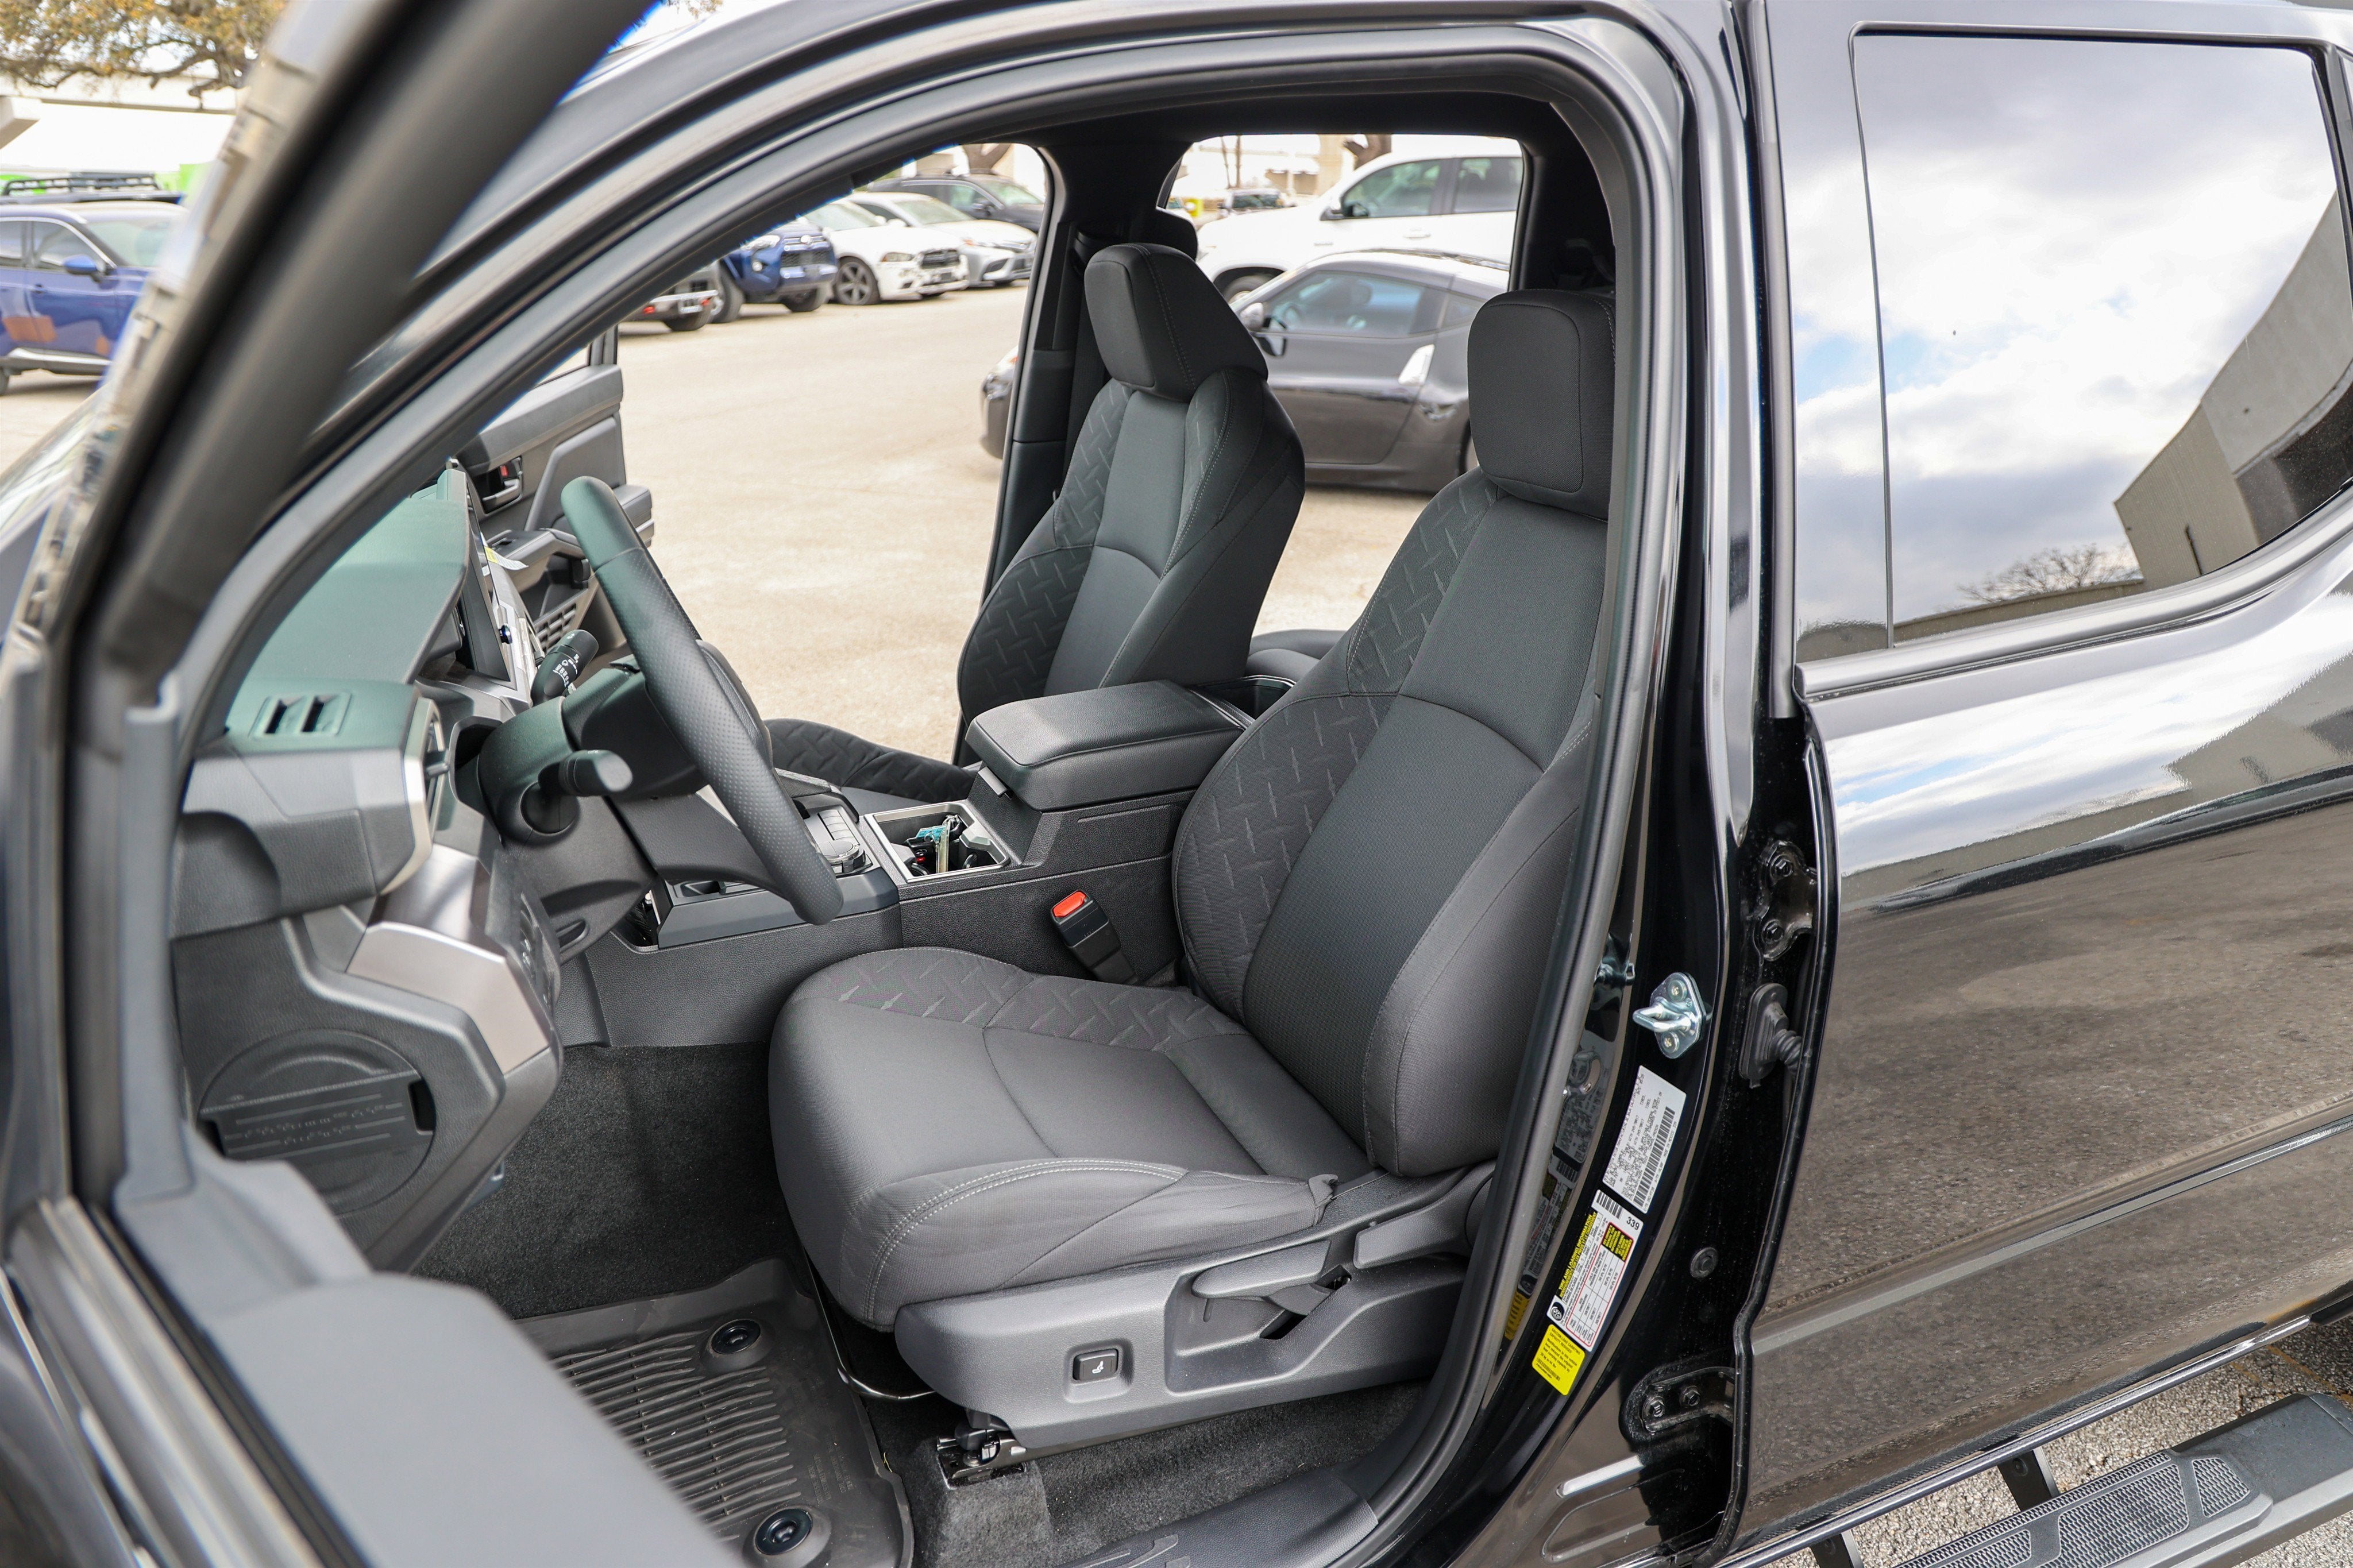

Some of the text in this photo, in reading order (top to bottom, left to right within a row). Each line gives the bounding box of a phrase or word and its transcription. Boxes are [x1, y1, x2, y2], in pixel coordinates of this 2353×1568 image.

[1625, 1215, 1640, 1231] 339
[1567, 1246, 1579, 1269] LOADING
[1576, 1214, 1592, 1248] INFORMATION
